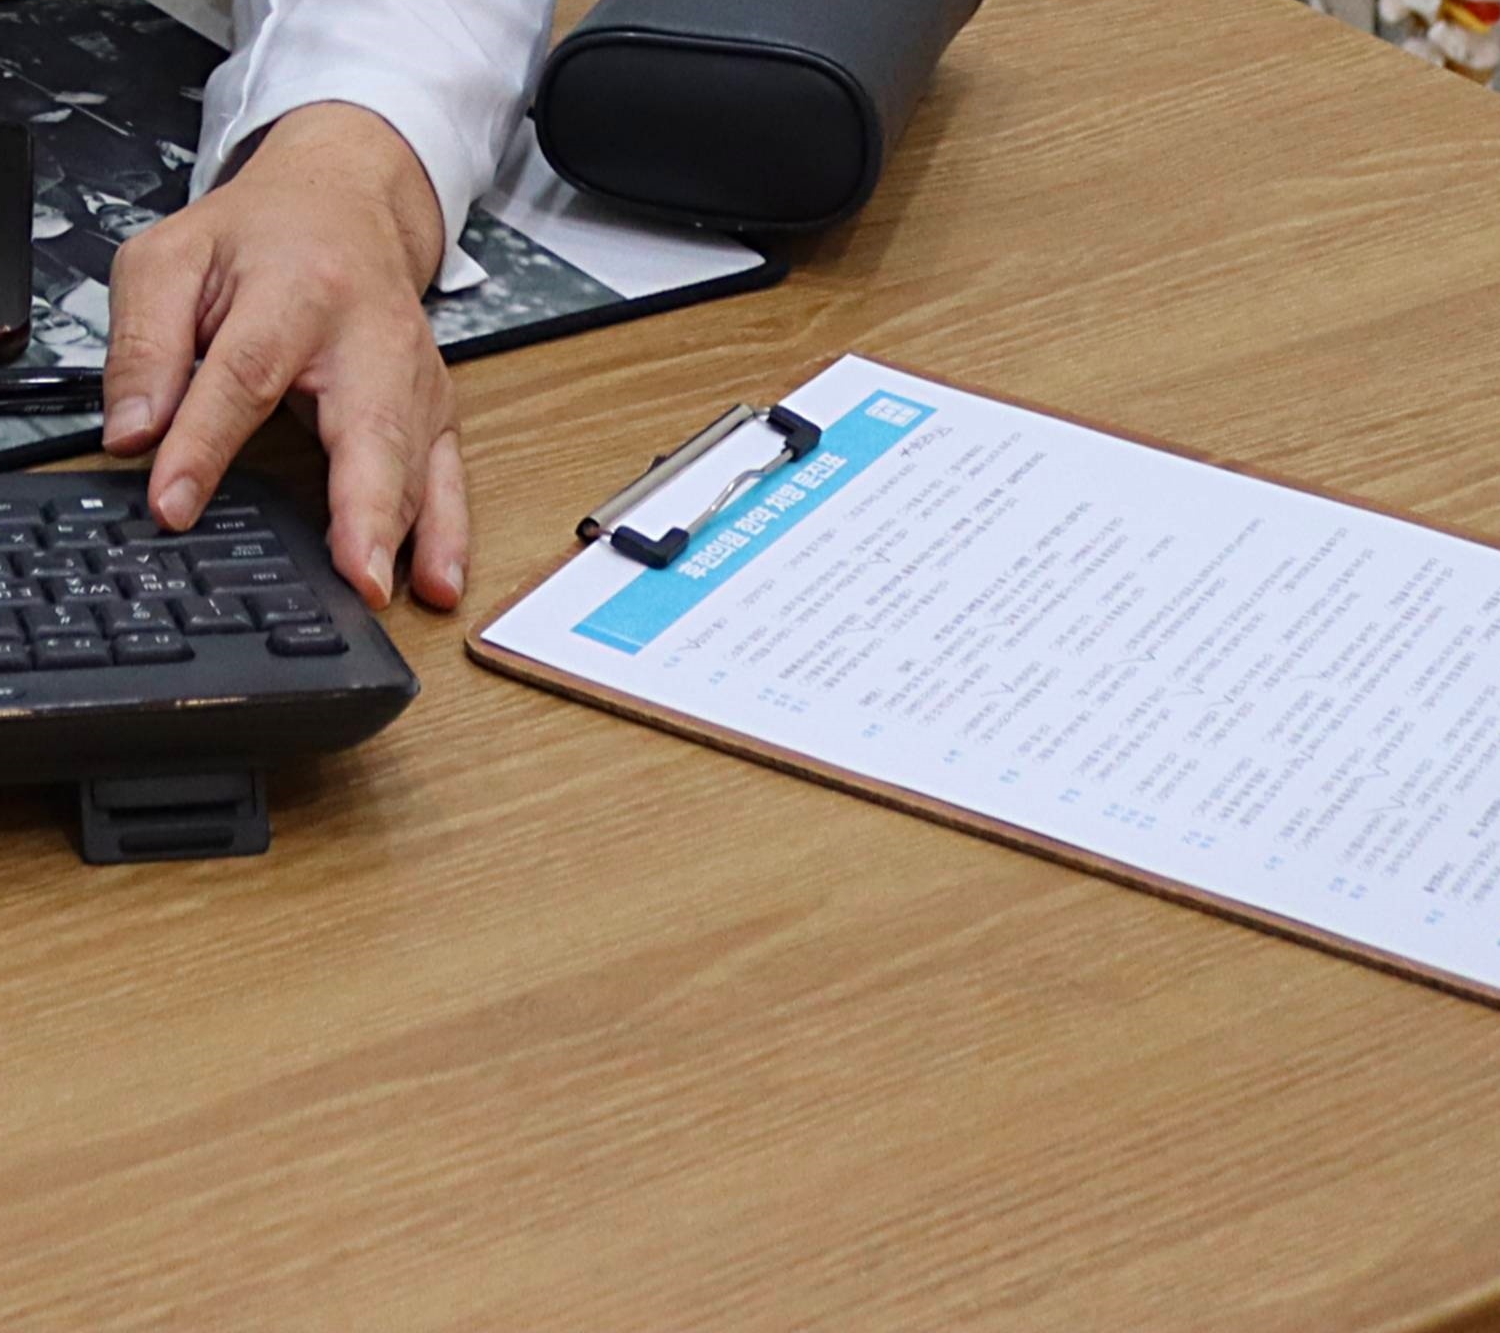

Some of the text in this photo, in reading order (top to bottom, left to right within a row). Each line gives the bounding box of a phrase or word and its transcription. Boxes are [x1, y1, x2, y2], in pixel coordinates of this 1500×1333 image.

[678, 451, 849, 579] 후한의원 한약 처방 문진표
